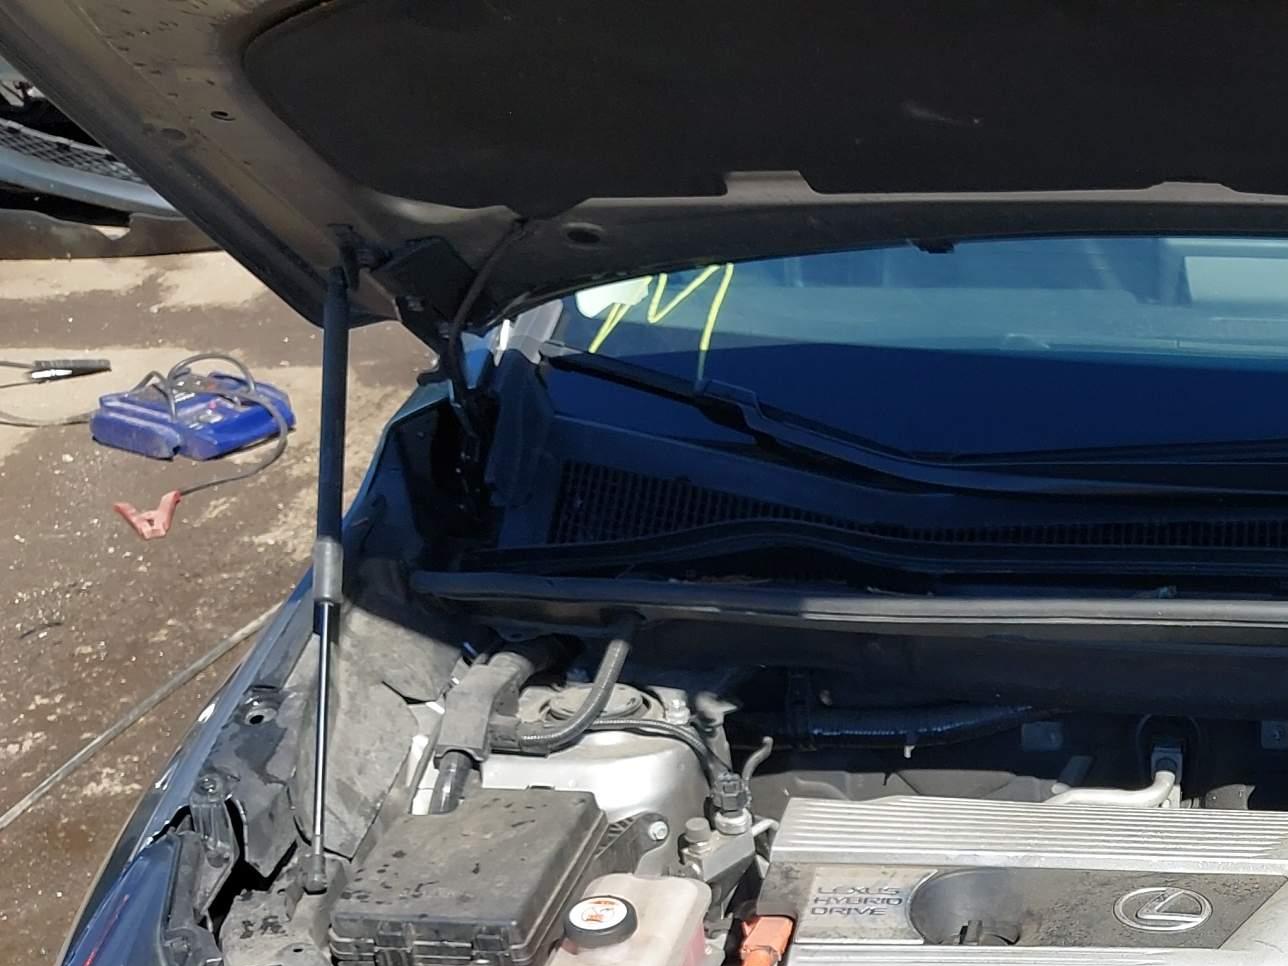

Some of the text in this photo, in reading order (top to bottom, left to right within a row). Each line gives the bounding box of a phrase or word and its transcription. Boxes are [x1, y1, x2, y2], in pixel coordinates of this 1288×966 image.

[817, 886, 900, 896] LEXUS
[814, 896, 903, 906] HYBRID
[810, 906, 889, 916] DRIVE
